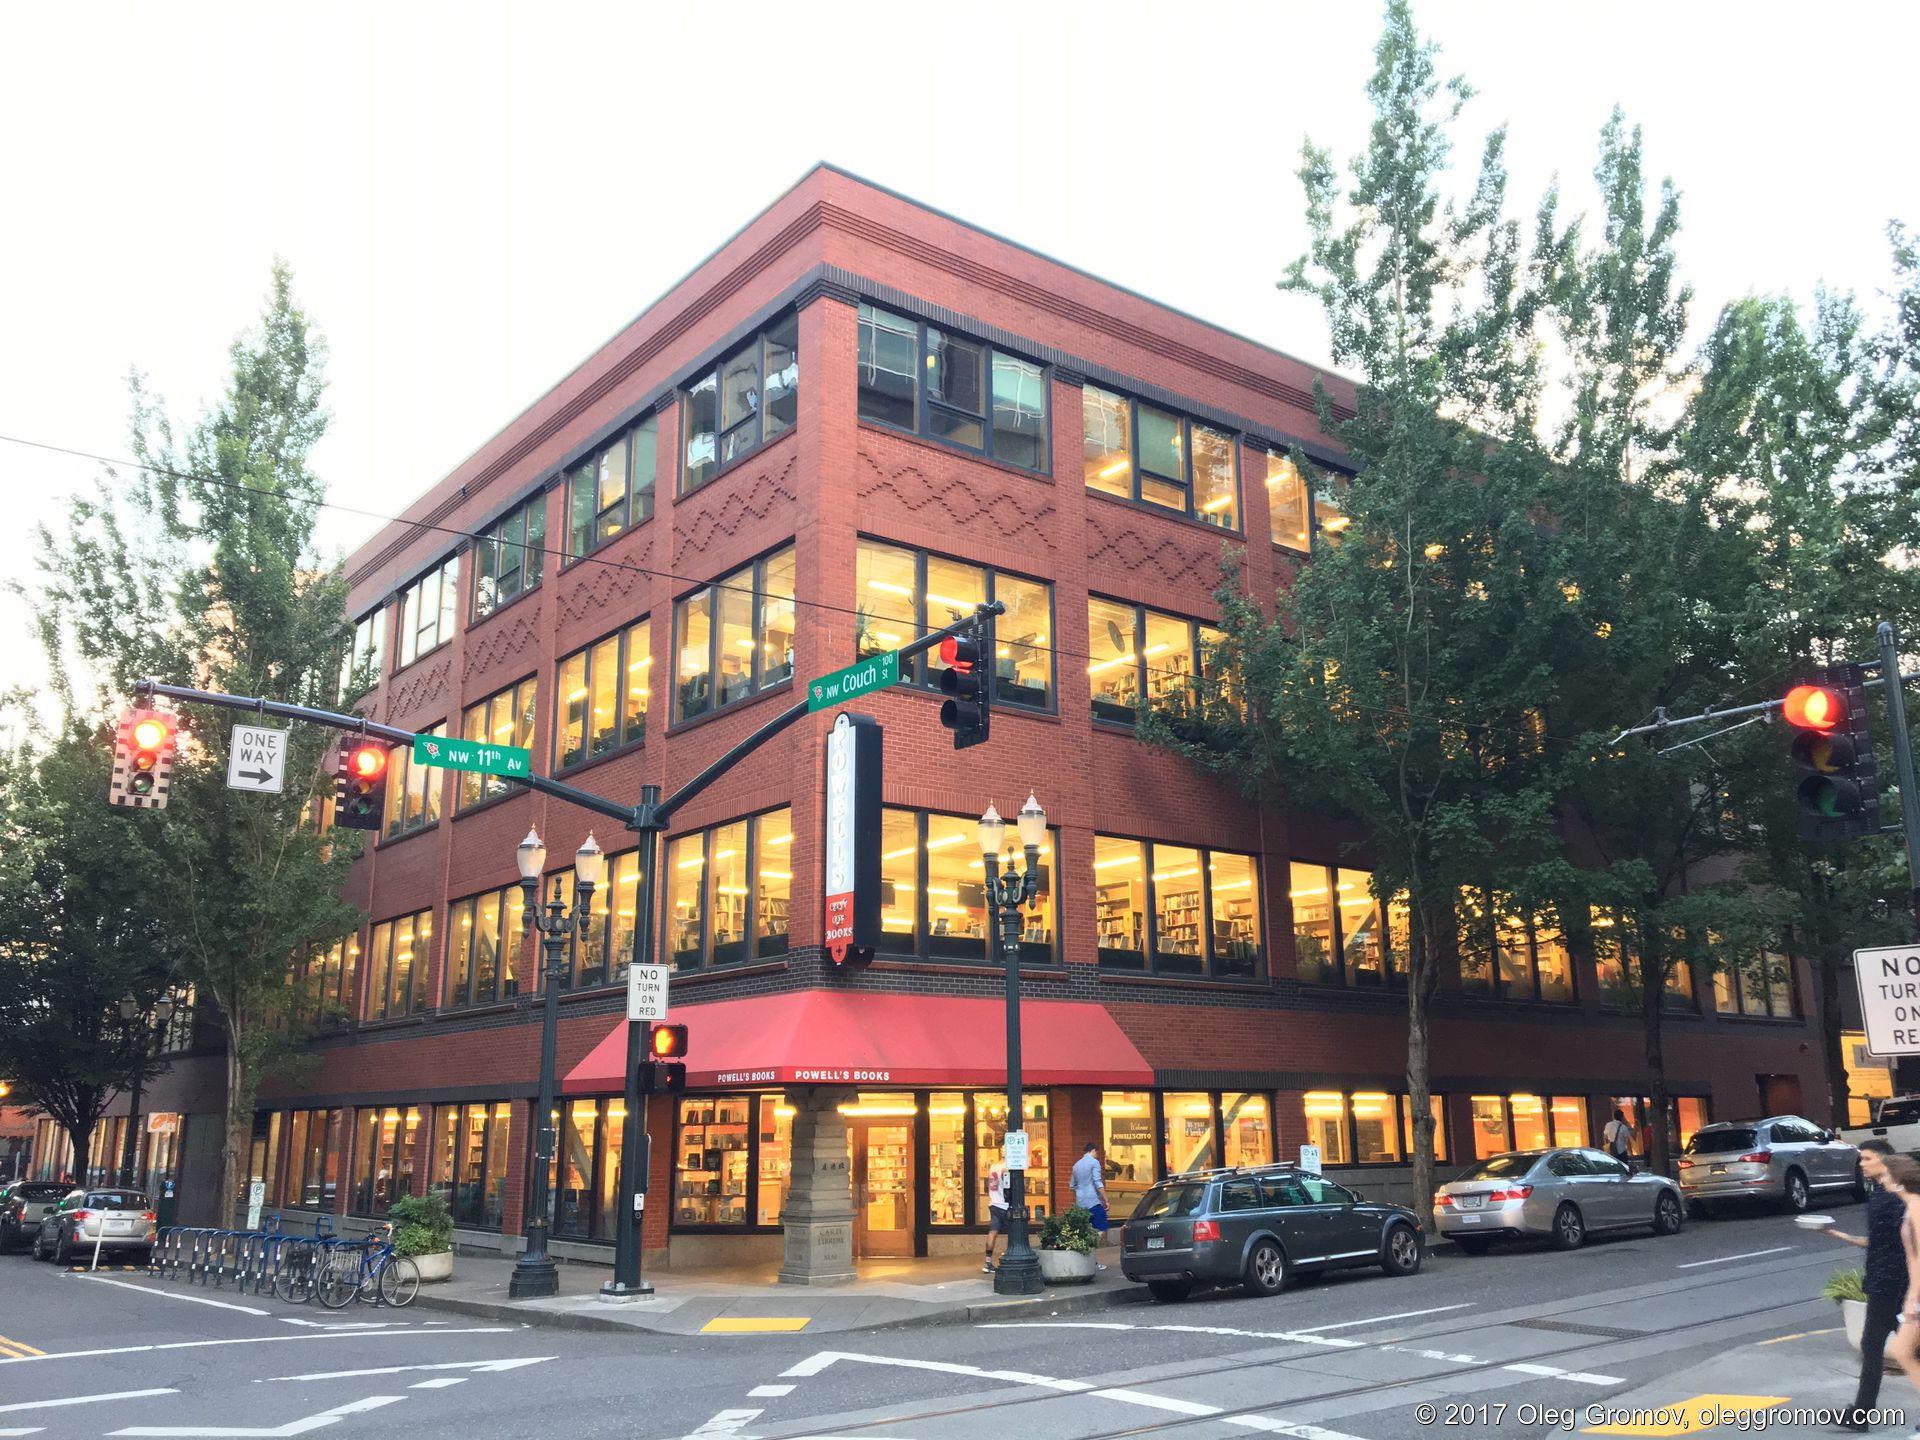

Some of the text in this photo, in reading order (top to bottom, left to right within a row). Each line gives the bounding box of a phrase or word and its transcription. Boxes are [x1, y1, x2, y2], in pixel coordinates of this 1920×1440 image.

[882, 654, 893, 667] 100
[826, 664, 888, 700] NW Couch St
[242, 732, 277, 749] ONE
[240, 748, 277, 765] WAY
[448, 749, 522, 770] NW 11th Av
[1882, 956, 1920, 977] NO
[640, 969, 658, 980] NO
[637, 983, 660, 992] TURN
[1878, 983, 1920, 1000] TUR
[641, 995, 655, 1004] ON
[639, 1006, 657, 1016] RED
[1893, 1029, 1920, 1045] RE
[717, 1071, 775, 1083] POWELL'S BOOKS
[795, 1070, 890, 1081] POWELL'S BOOKS
